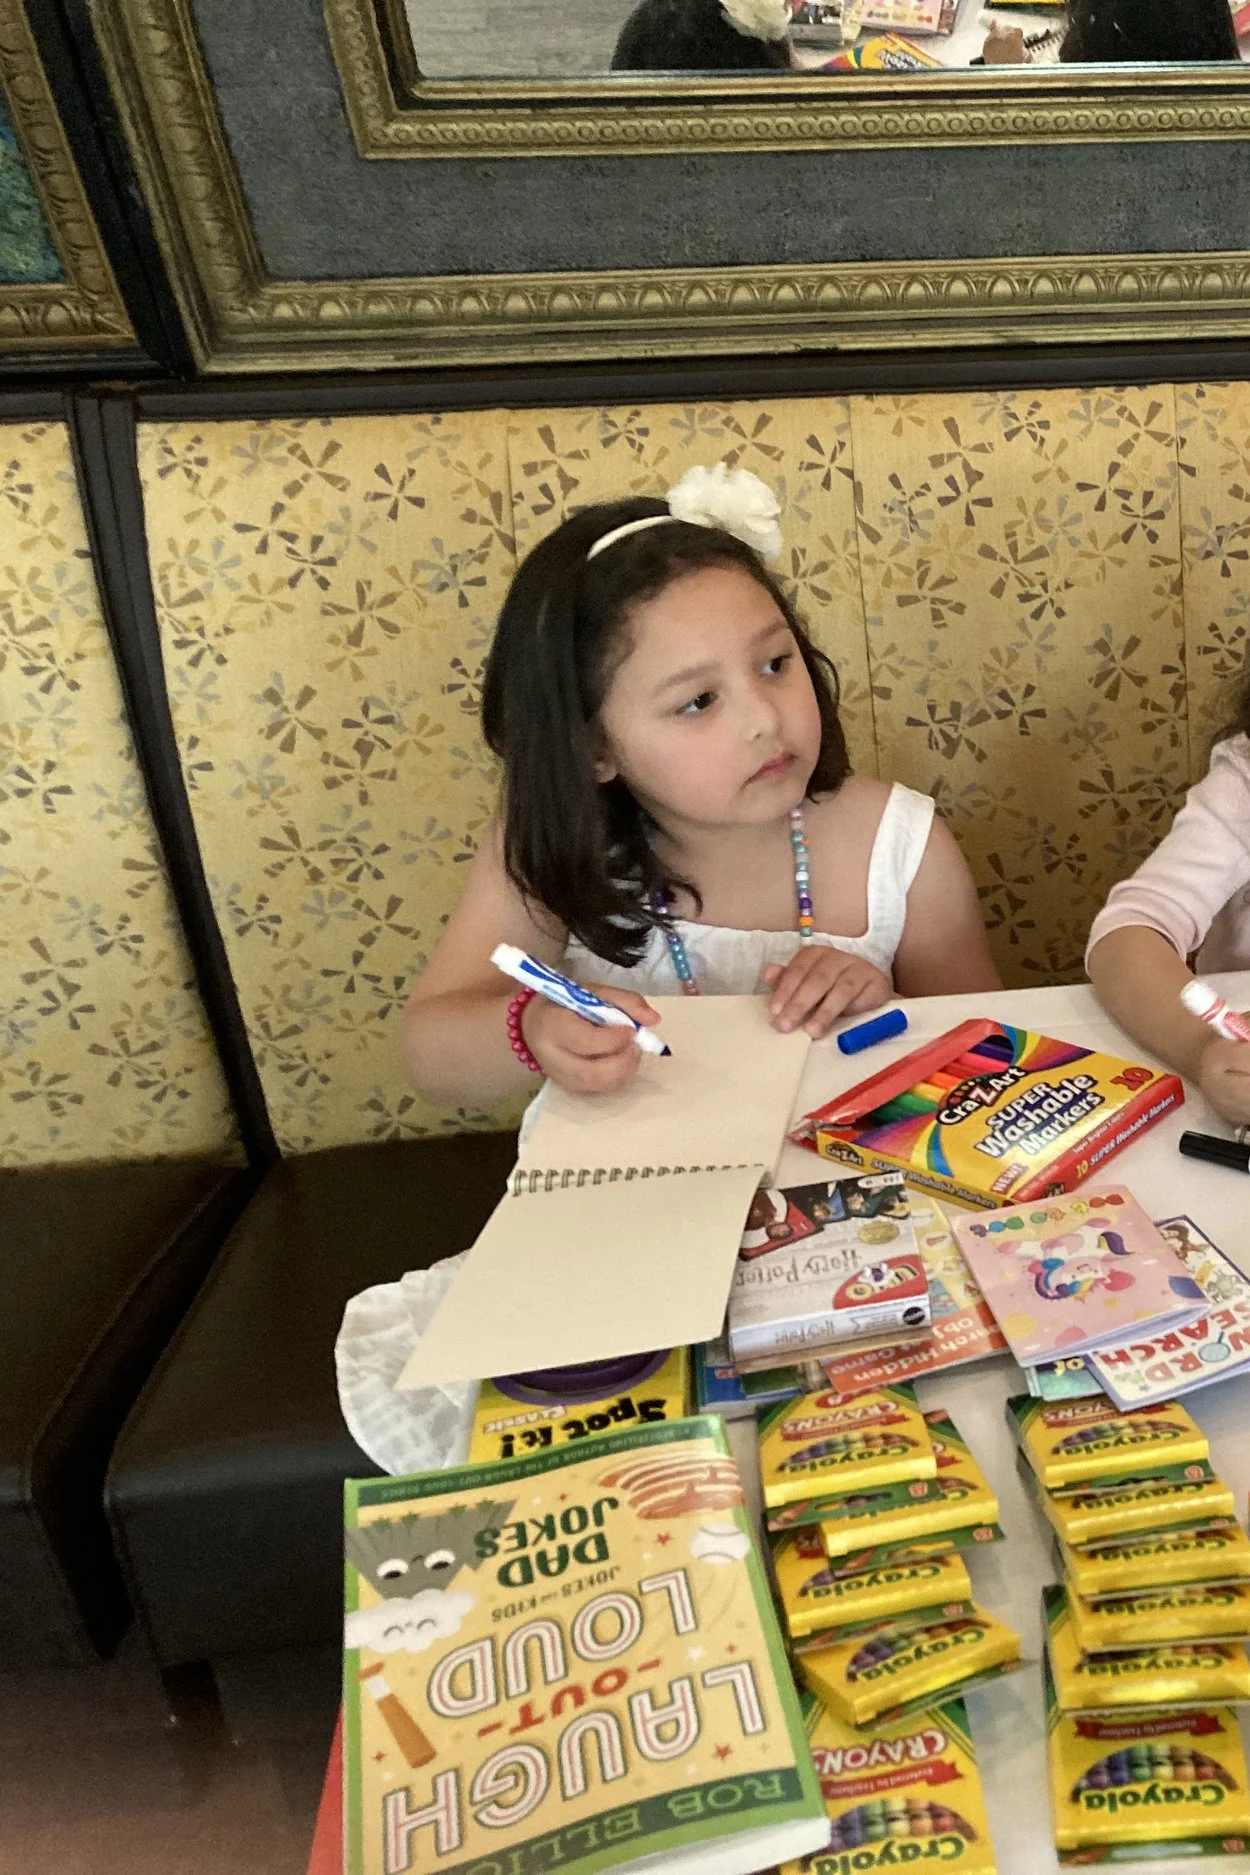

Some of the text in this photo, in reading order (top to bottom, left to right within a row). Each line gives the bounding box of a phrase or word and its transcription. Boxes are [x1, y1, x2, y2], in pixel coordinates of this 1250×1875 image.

[1109, 1067, 1154, 1091] 10
[978, 1073, 1098, 1158] Washable
[986, 1082, 1051, 1128] SUPER
[1016, 1092, 1102, 1155] Markers
[1076, 1160, 1089, 1177] 10
[734, 1250, 858, 1288] Harry Potter
[561, 1397, 667, 1440] Spot
[783, 1401, 898, 1433] CRAYONS
[788, 1446, 909, 1474] Crayola
[1064, 1431, 1181, 1457] Crayola
[1080, 1484, 1204, 1510] Crayola
[472, 1497, 620, 1559] JOKES
[495, 1532, 610, 1588] DAD
[1100, 1539, 1228, 1562] Crayola
[561, 1566, 620, 1596] JOKES
[812, 1565, 941, 1599] Crayola
[490, 1596, 537, 1621] KIDS
[1104, 1593, 1236, 1617] Crayola
[426, 1568, 698, 1719] LOUD
[861, 1627, 986, 1683] Crayola
[1087, 1655, 1224, 1677] Crayola
[381, 1661, 767, 1875] LAUGH
[667, 1774, 786, 1819] ROB
[1083, 1784, 1225, 1814] Crayola
[813, 1836, 966, 1875] Crayola
